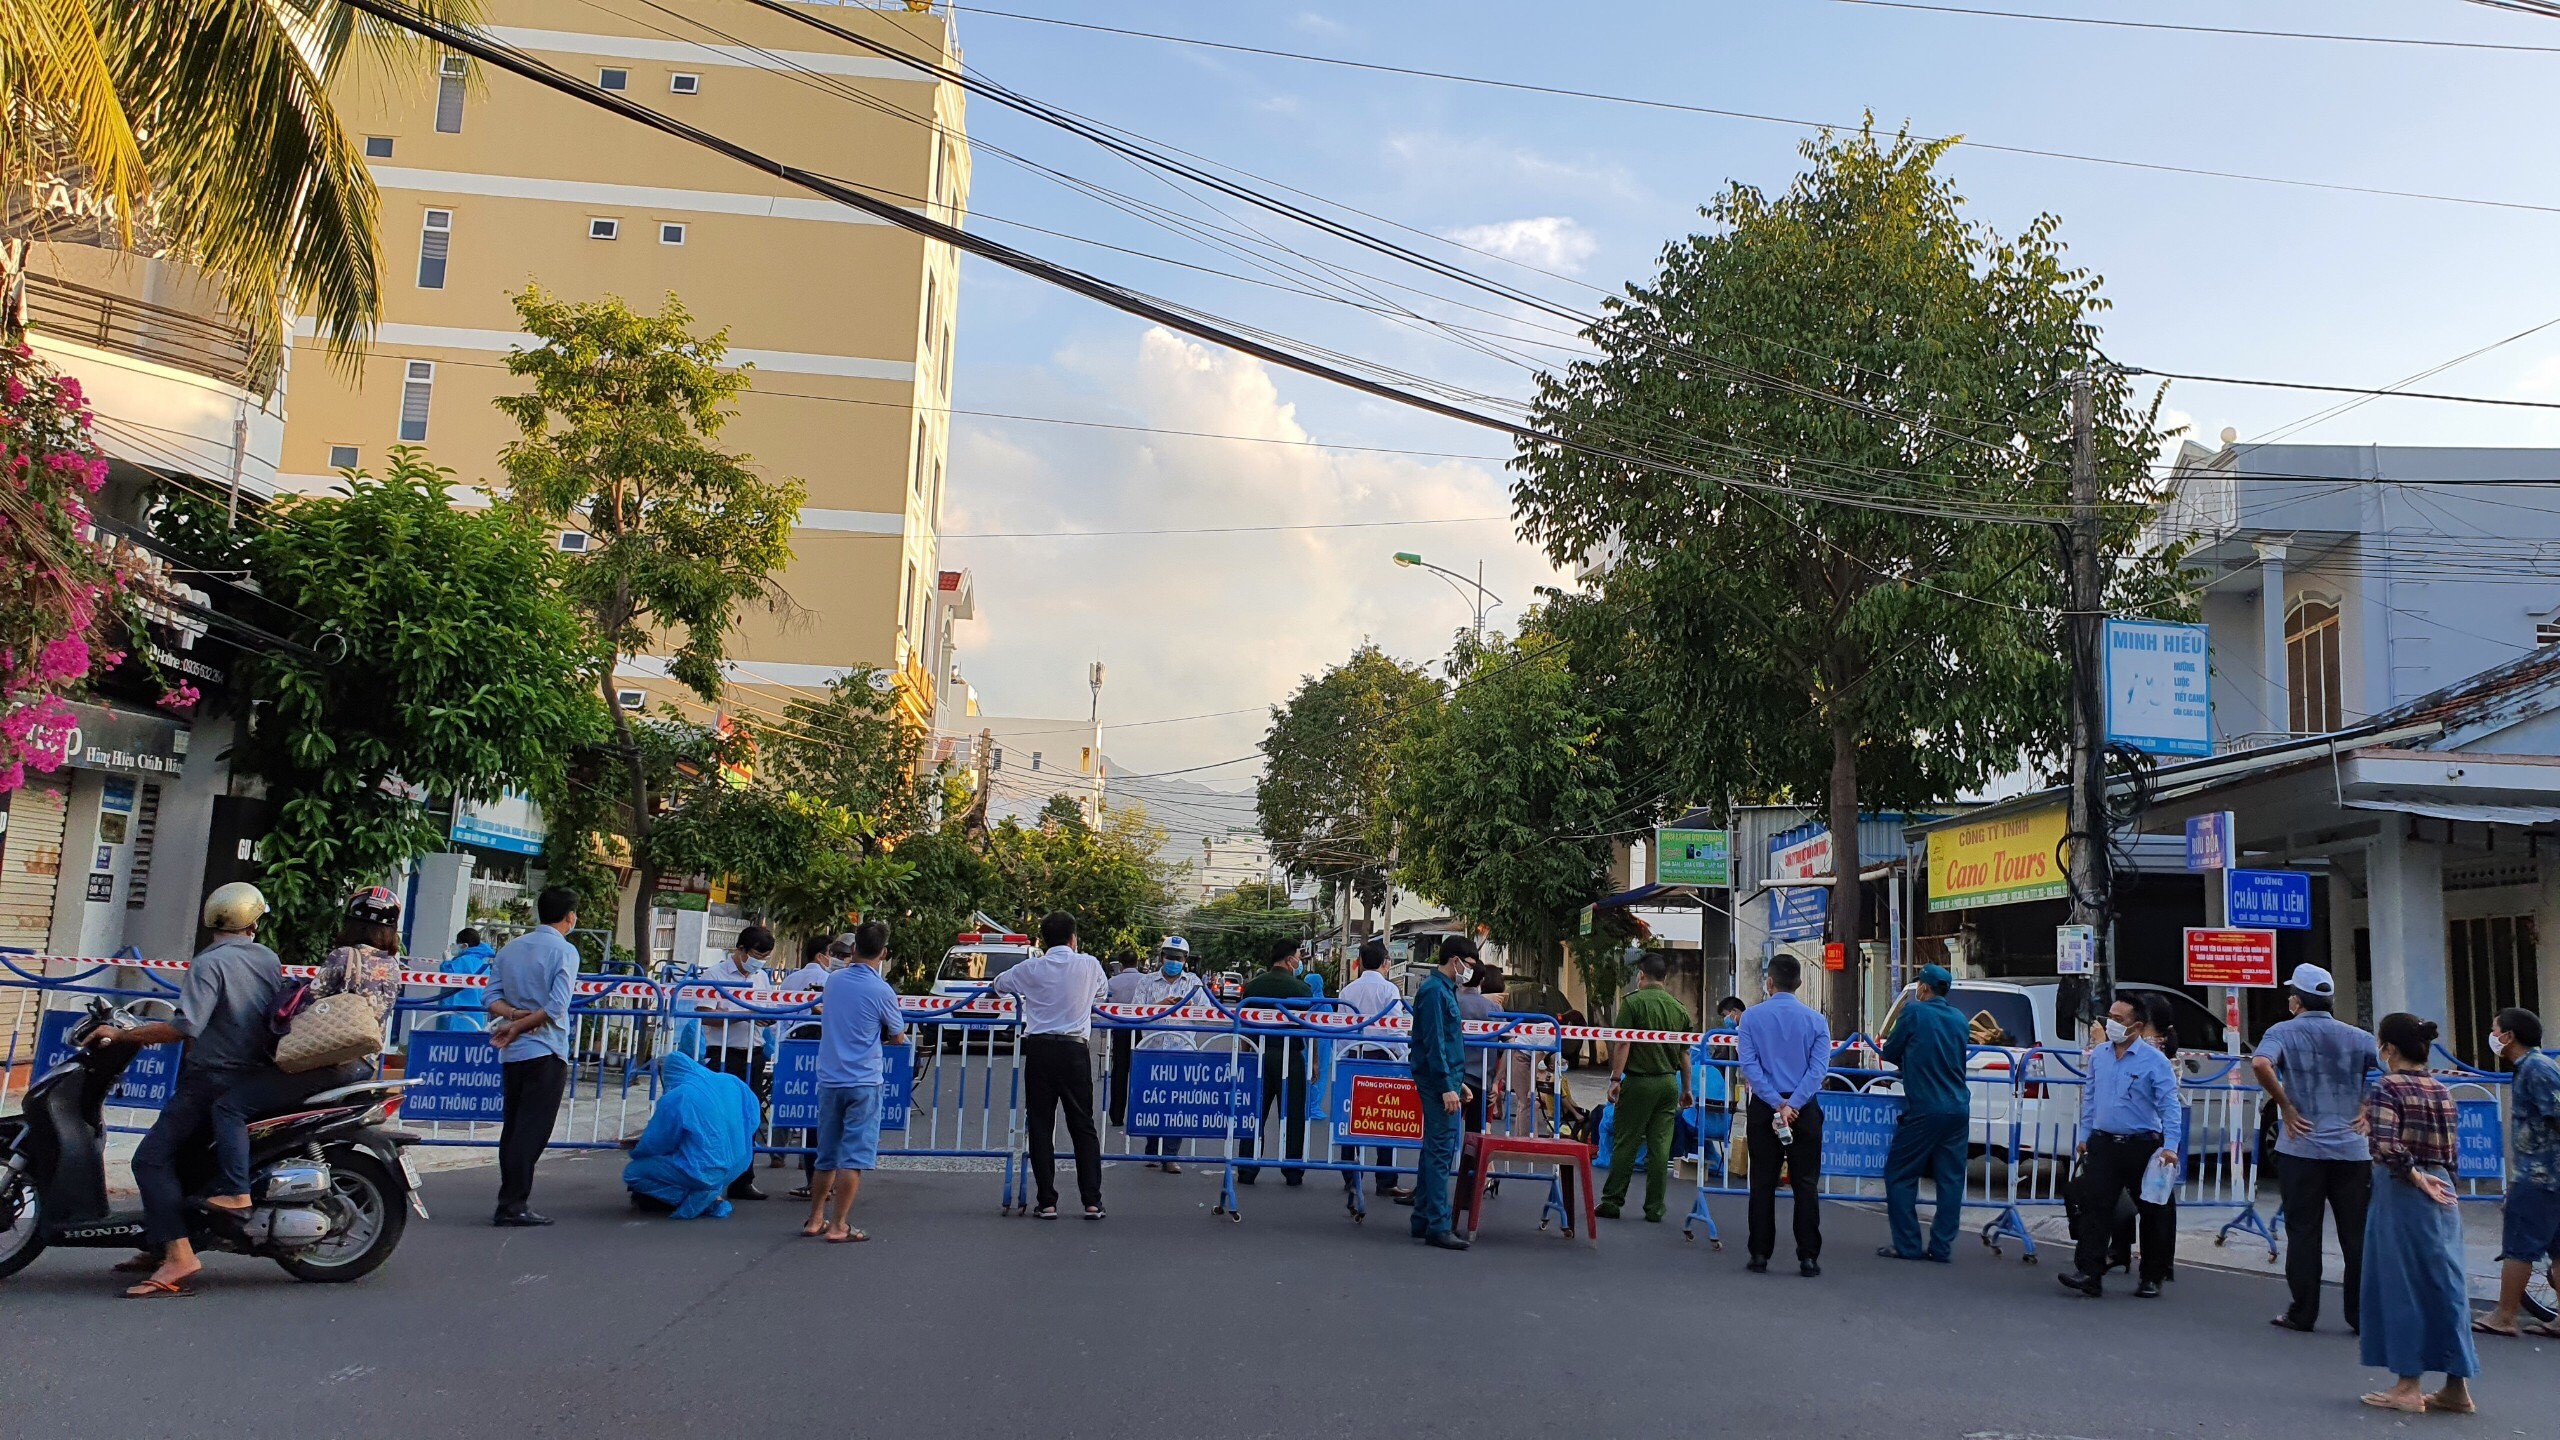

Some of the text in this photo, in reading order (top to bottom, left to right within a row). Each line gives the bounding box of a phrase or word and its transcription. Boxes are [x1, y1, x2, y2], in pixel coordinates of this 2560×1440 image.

[2113, 630, 2202, 654] MINH HIẾU
[86, 746, 111, 768] Hàng
[1959, 818, 2030, 847] CÔNG TY TNHH
[237, 838, 252, 861] GU
[1946, 851, 2046, 891] Cano Tours
[2254, 876, 2284, 887] ĐƯỜNG
[2234, 887, 2305, 913] CHÂU VĂN LIÊM
[428, 1045, 459, 1063] KHU
[464, 1044, 494, 1067] VỰC
[794, 1055, 819, 1072] KH
[135, 1057, 165, 1077] TIỆN
[1150, 1064, 1178, 1082] KHU
[1183, 1063, 1211, 1086] VỰC
[419, 1067, 502, 1088] CÁC PHƯƠNG
[1357, 1080, 1378, 1088] PHÒNG
[1378, 1082, 1393, 1090] DỊCH
[784, 1079, 809, 1096] CÁC
[409, 1093, 505, 1112] GIAO THÔNG ĐƯỜ
[1142, 1087, 1251, 1108] CÁC PHƯƠNG TỆN
[1376, 1093, 1400, 1106] CẤM
[779, 1104, 805, 1118] GIAO
[1360, 1105, 1379, 1119] TẬP
[1380, 1108, 1416, 1120] TRUNG
[1821, 1105, 1842, 1122] HU
[1845, 1104, 1871, 1126] VỰC
[1135, 1112, 1160, 1127] GIAO
[1163, 1110, 1199, 1129] THÔNG
[1241, 1112, 1257, 1132] BỘ
[1354, 1119, 1420, 1134] ĐÔNG NGƯỜI
[1834, 1130, 1880, 1146] PHƯƠNG
[2464, 1133, 2492, 1152] TIỆN
[1829, 1150, 1861, 1168] THÔNG
[1865, 1152, 1889, 1169] ĐƯỜ
[63, 1223, 145, 1240] HONDA
